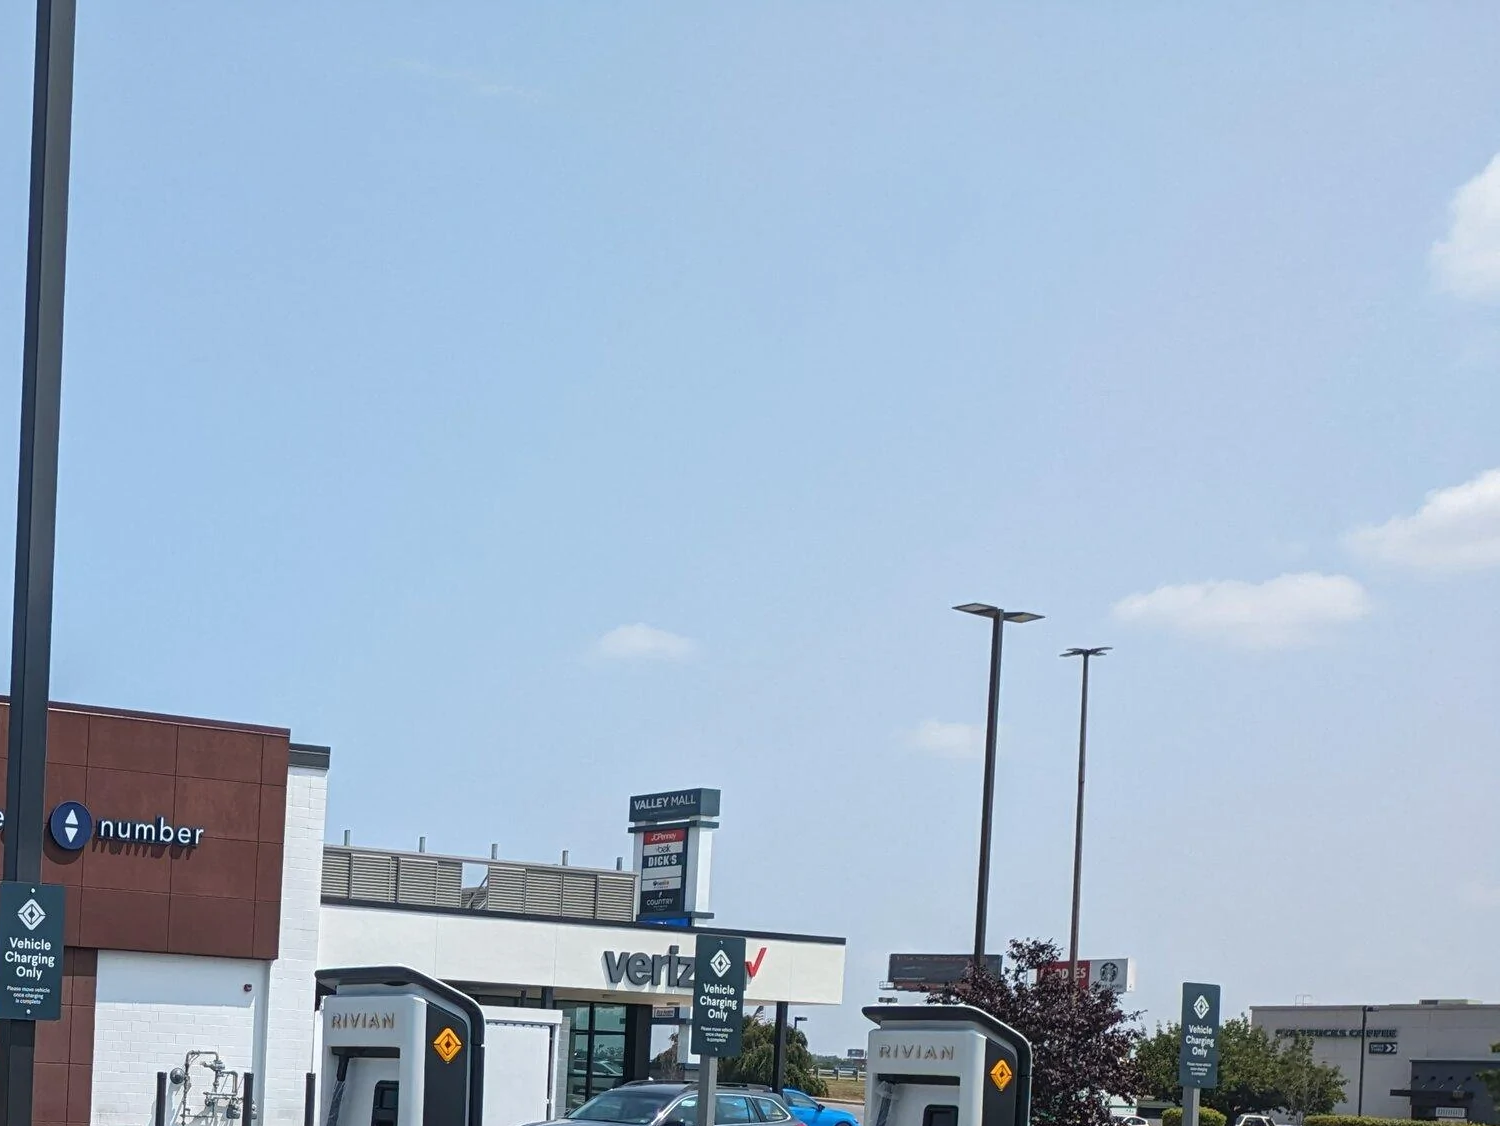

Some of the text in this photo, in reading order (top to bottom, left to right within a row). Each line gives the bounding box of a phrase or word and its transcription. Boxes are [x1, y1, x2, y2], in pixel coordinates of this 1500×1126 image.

[634, 794, 696, 810] VALLEY MALL
[100, 816, 205, 845] number
[648, 855, 678, 867] DICK'S
[9, 936, 52, 951] Vehicle
[4, 951, 56, 968] Charging
[602, 945, 695, 988] veriz
[15, 965, 43, 981] Only
[703, 982, 735, 995] Vehicle
[699, 995, 737, 1010] Charging
[331, 1013, 395, 1029] RIVIAN
[707, 1008, 728, 1022] Only
[1188, 1024, 1213, 1035] Vehicle
[1185, 1035, 1215, 1048] Charging
[878, 1045, 955, 1060] RIVIAN
[1191, 1046, 1208, 1058] Only
